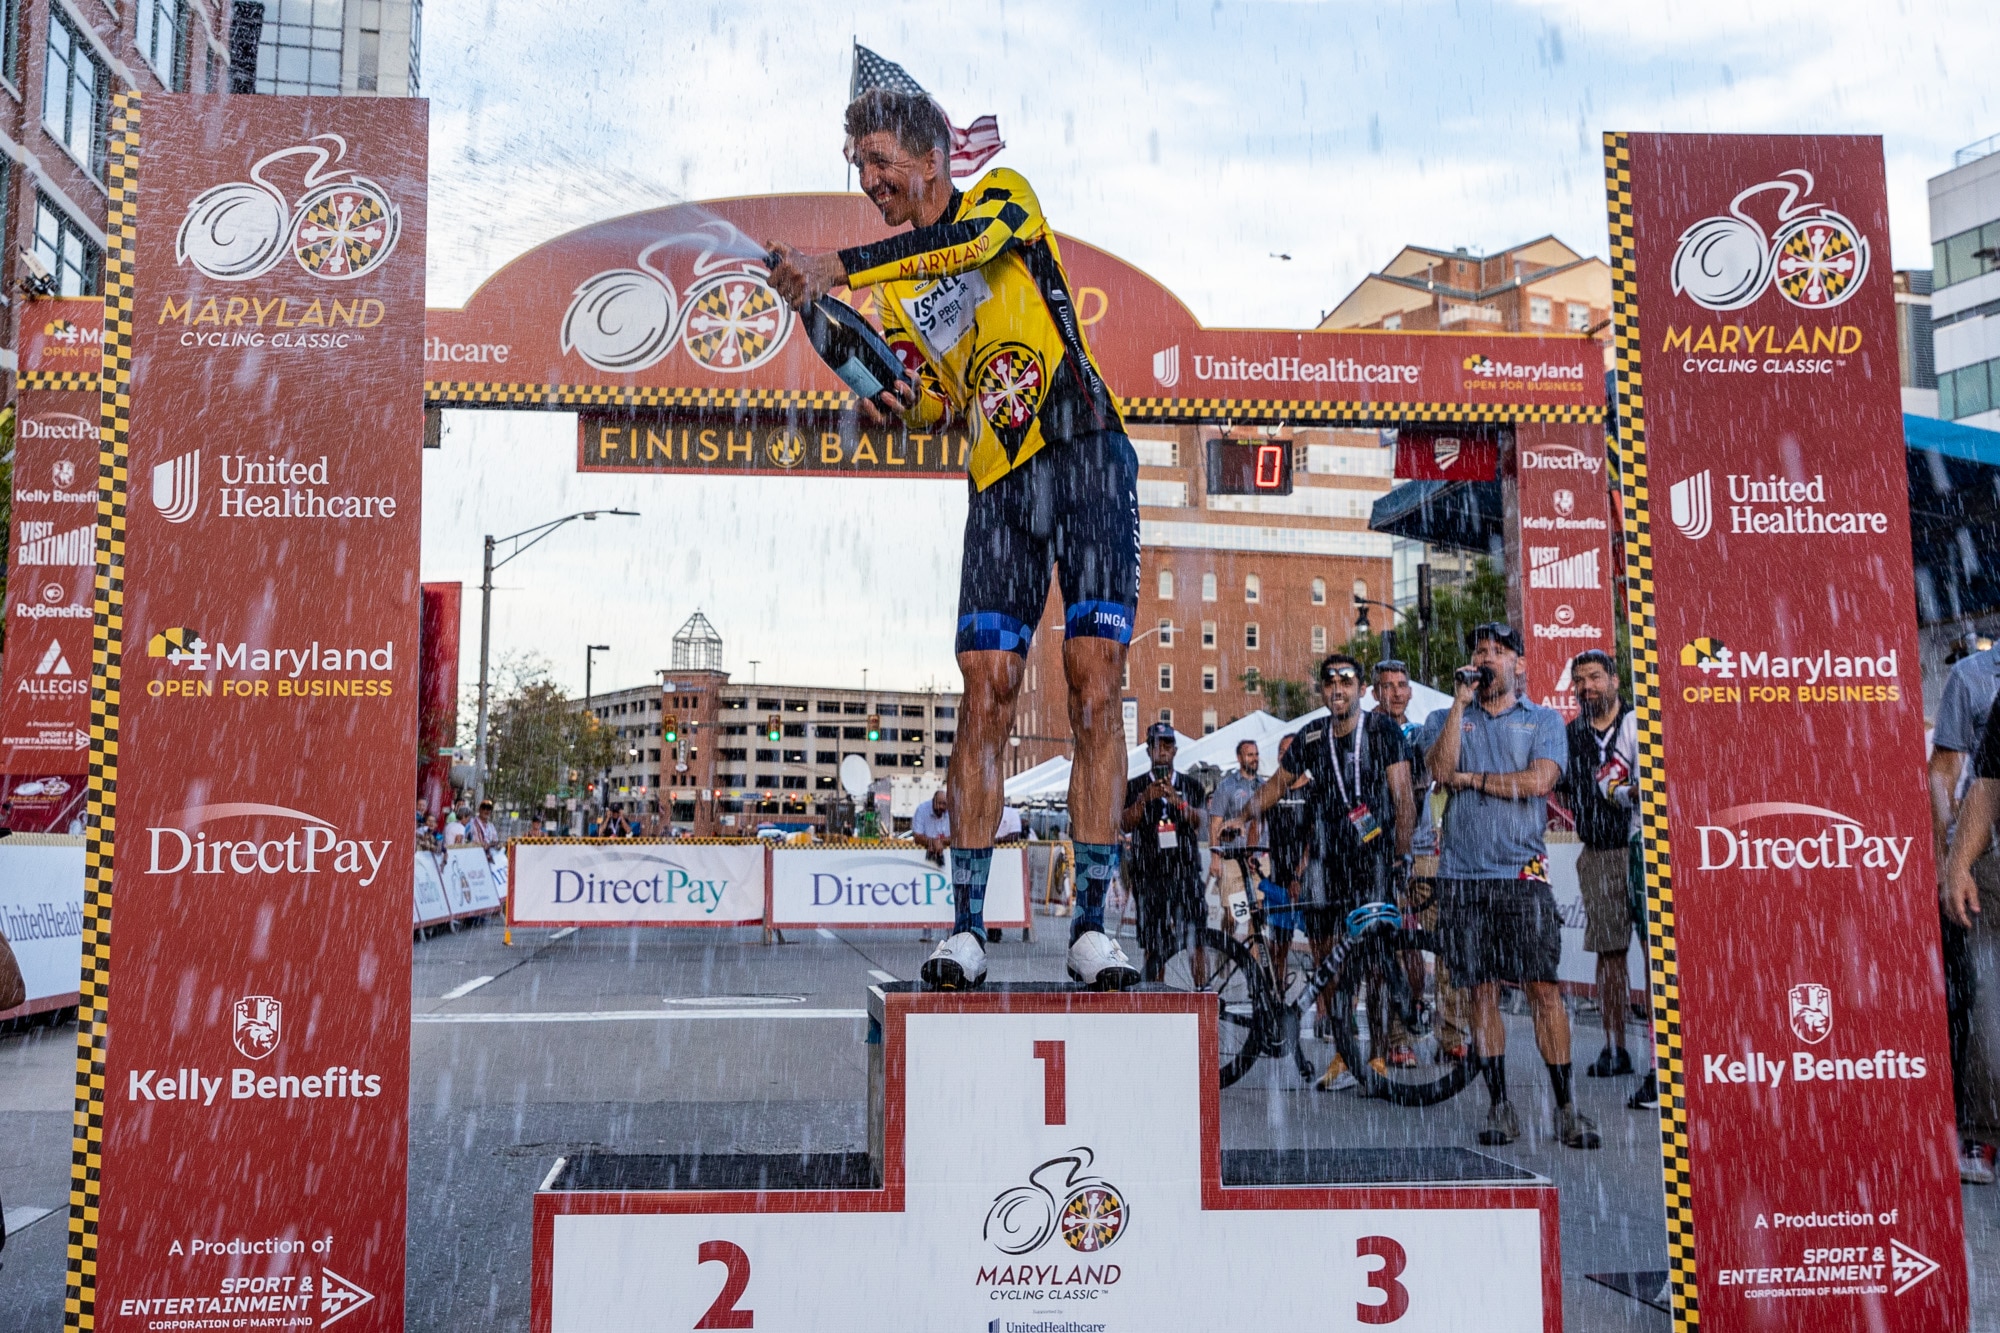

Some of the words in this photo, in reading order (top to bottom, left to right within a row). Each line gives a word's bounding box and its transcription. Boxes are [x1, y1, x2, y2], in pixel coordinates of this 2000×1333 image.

[900, 235, 990, 277] MARYLAND
[158, 297, 386, 328] MARYLAND
[180, 332, 265, 348] CYCLING
[1662, 325, 1863, 355] MARYLAND
[43, 347, 79, 357] OPEN
[1194, 356, 1419, 383] UnitedHealthcare
[1496, 362, 1583, 381] Maryland
[1683, 359, 1758, 374] CYCLING
[1463, 380, 1496, 390] OPEN
[1500, 381, 1523, 390] FOR
[1527, 381, 1584, 392] BUSINESS
[21, 420, 100, 444] DirectPa
[600, 428, 752, 461] FINISH
[220, 456, 329, 486] United
[1522, 451, 1603, 474] DirectPay
[16, 489, 51, 504] Kelly
[1727, 474, 1826, 503] United
[219, 489, 397, 518] Healthcare
[1523, 516, 1555, 531] Kelly
[1556, 516, 1607, 530] Benefits
[1729, 505, 1888, 534] Healthcare
[20, 521, 54, 544] VISIT
[1529, 546, 1560, 568] VISIT
[1529, 548, 1601, 589] BALTIMORE
[17, 603, 93, 620] RxBenefits
[1094, 611, 1126, 629] JINGA
[1533, 623, 1602, 640] RxBenefits
[216, 641, 393, 678] Maryland
[1740, 649, 1898, 684] Maryland
[17, 679, 88, 694] ALLEGIS
[146, 680, 213, 697] OPEN
[222, 679, 269, 696] FOR
[278, 679, 393, 697] BUSINESS
[1683, 686, 1741, 703] OPEN
[1749, 686, 1790, 702] FOR
[1798, 685, 1900, 702] BUSINESS
[2, 737, 74, 745] ENTERTAINMENT
[39, 730, 67, 738] SPORT
[144, 826, 393, 887] DirectPay
[1695, 824, 1914, 881] DirectPay
[553, 869, 728, 914] DirectPay
[1703, 1052, 1785, 1088] Kelly
[1792, 1049, 1926, 1082] Benefits
[129, 1068, 222, 1106] Kelly
[231, 1066, 381, 1099] Benefits
[1033, 1040, 1066, 1125] 1
[1754, 1213, 1768, 1229] A
[1774, 1211, 1874, 1228] Production
[1878, 1209, 1898, 1226] of
[168, 1241, 184, 1256] A
[191, 1237, 305, 1255] Production
[312, 1236, 333, 1253] of
[1803, 1246, 1868, 1264] SPORT
[1872, 1247, 1885, 1262] &
[220, 1276, 295, 1294] SPORT
[299, 1276, 314, 1292] &
[693, 1240, 754, 1330] 2
[975, 1264, 1122, 1286] MARYLAND
[1355, 1236, 1410, 1325] 3
[1718, 1264, 1885, 1286] ENTERTAINMENT
[990, 1290, 1044, 1301] CYCLING
[1744, 1287, 1815, 1299] CORPORATION
[1817, 1287, 1830, 1296] OF
[1832, 1285, 1888, 1295] MARYLAND
[120, 1294, 313, 1316] ENTERTAINMENT
[149, 1319, 230, 1330] CORPORATION
[233, 1319, 248, 1328] OF
[250, 1317, 313, 1327] MARYLAND
[1006, 1321, 1105, 1333] UnitedHealthcare
